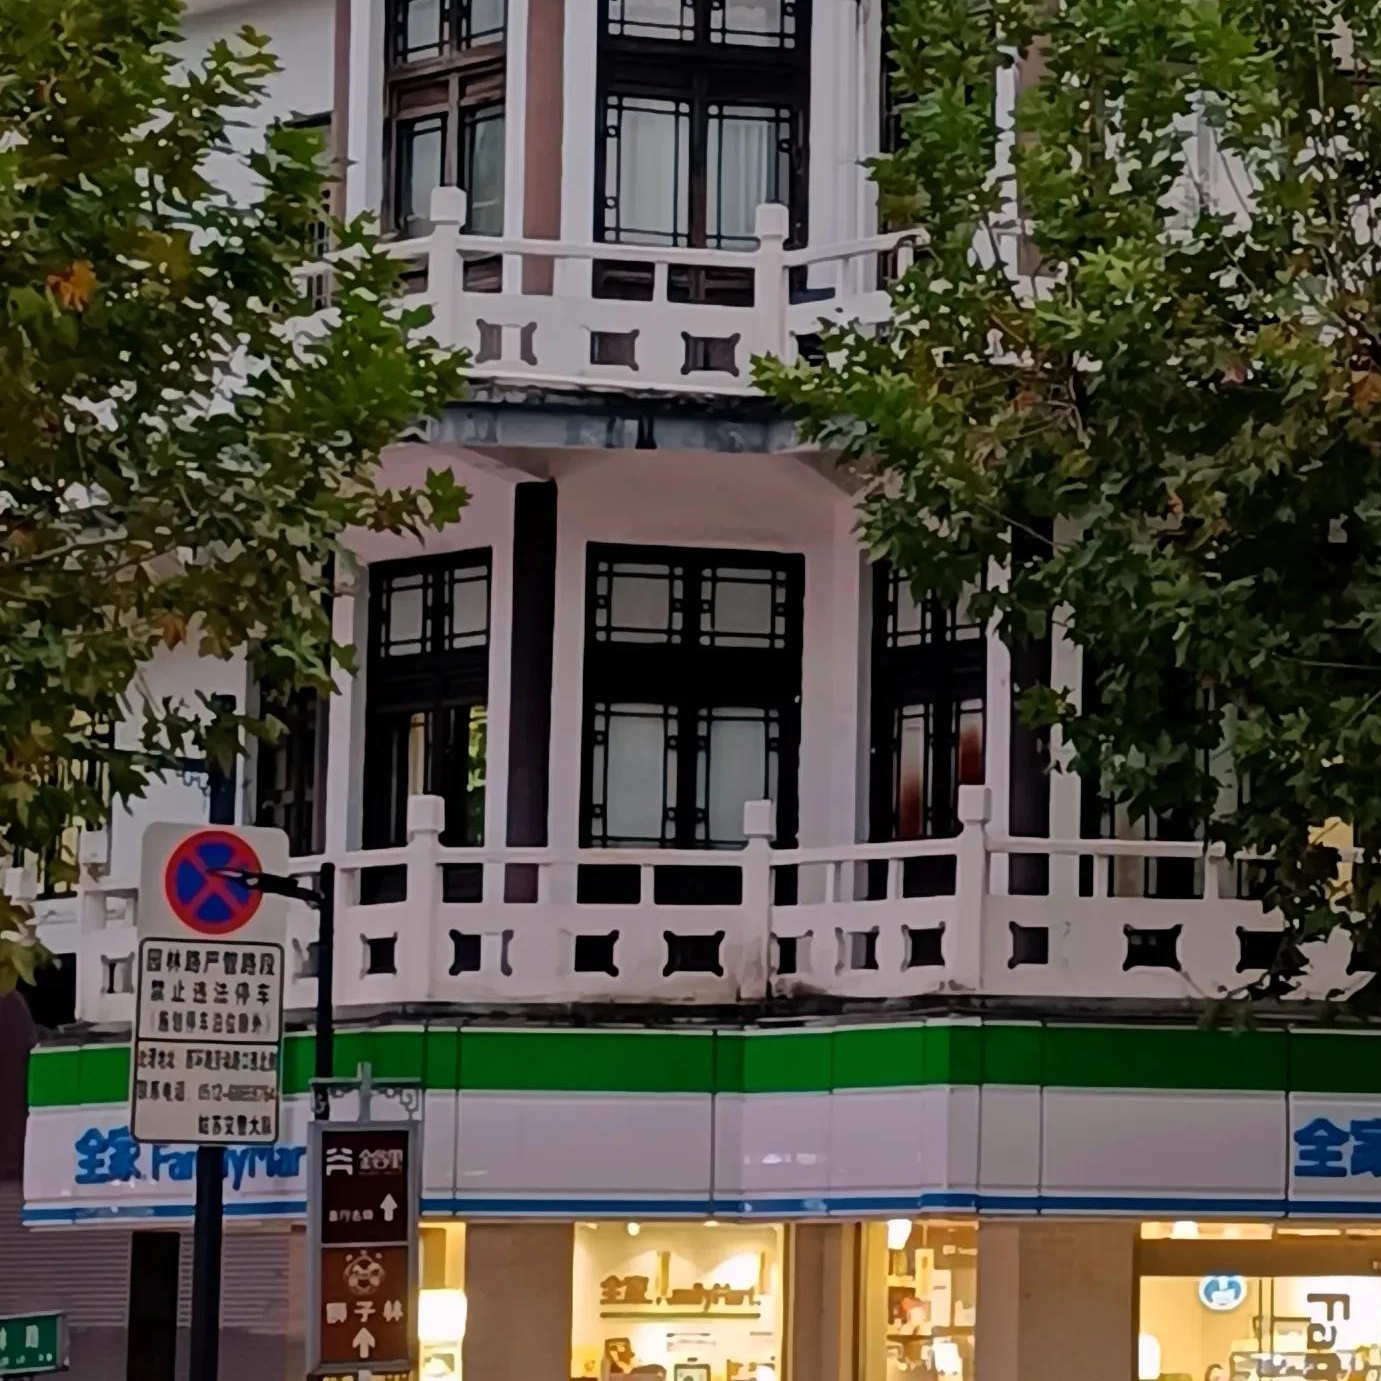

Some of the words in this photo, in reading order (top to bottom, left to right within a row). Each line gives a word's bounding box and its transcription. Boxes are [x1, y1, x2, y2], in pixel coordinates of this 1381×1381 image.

[150, 979, 270, 1005] 禁止违法停车
[75, 1126, 141, 1184] 全家
